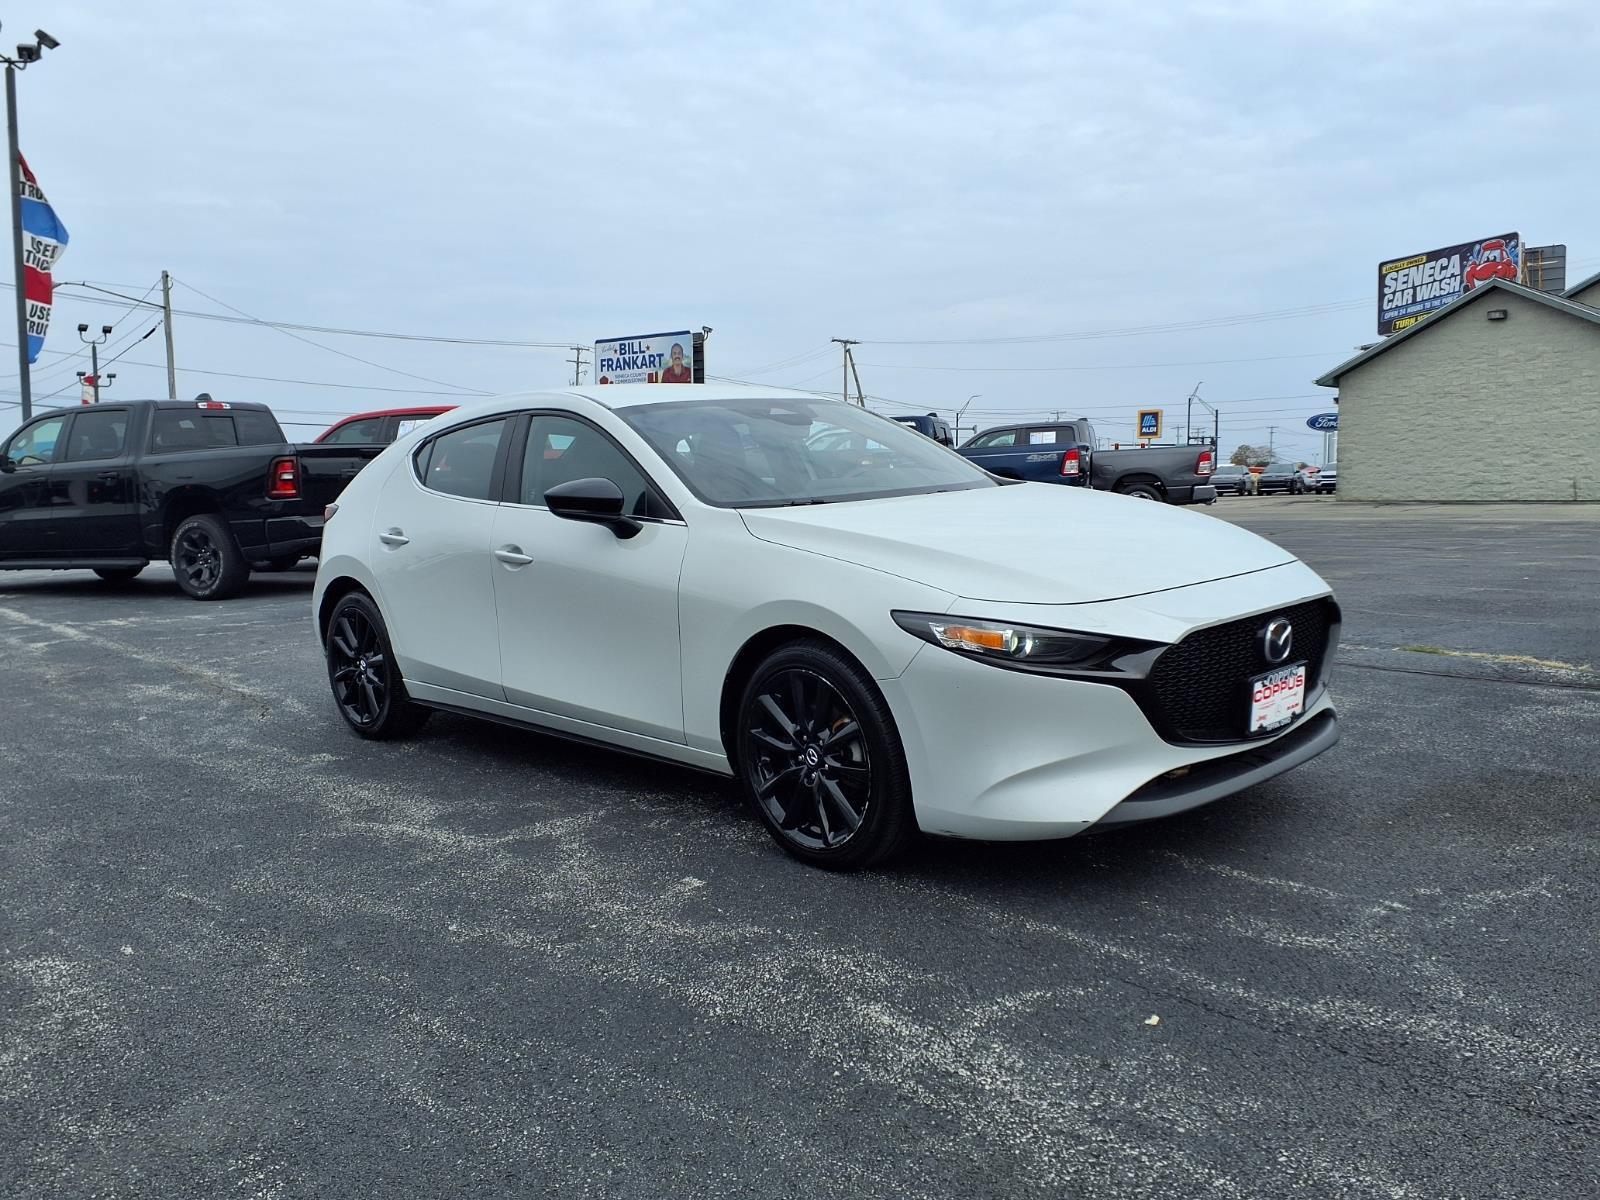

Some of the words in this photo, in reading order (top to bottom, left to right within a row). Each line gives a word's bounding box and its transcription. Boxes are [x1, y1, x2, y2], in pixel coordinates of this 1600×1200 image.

[1384, 254, 1460, 294] SENECA
[1383, 290, 1413, 310] CAR
[1416, 276, 1461, 301] WASH
[1384, 310, 1399, 319] OPEN
[1407, 304, 1424, 314] HOURS
[1395, 316, 1416, 330] TURN
[619, 341, 646, 356] BILL
[600, 353, 664, 372] FRANKART
[1253, 674, 1304, 703] COPPUS
